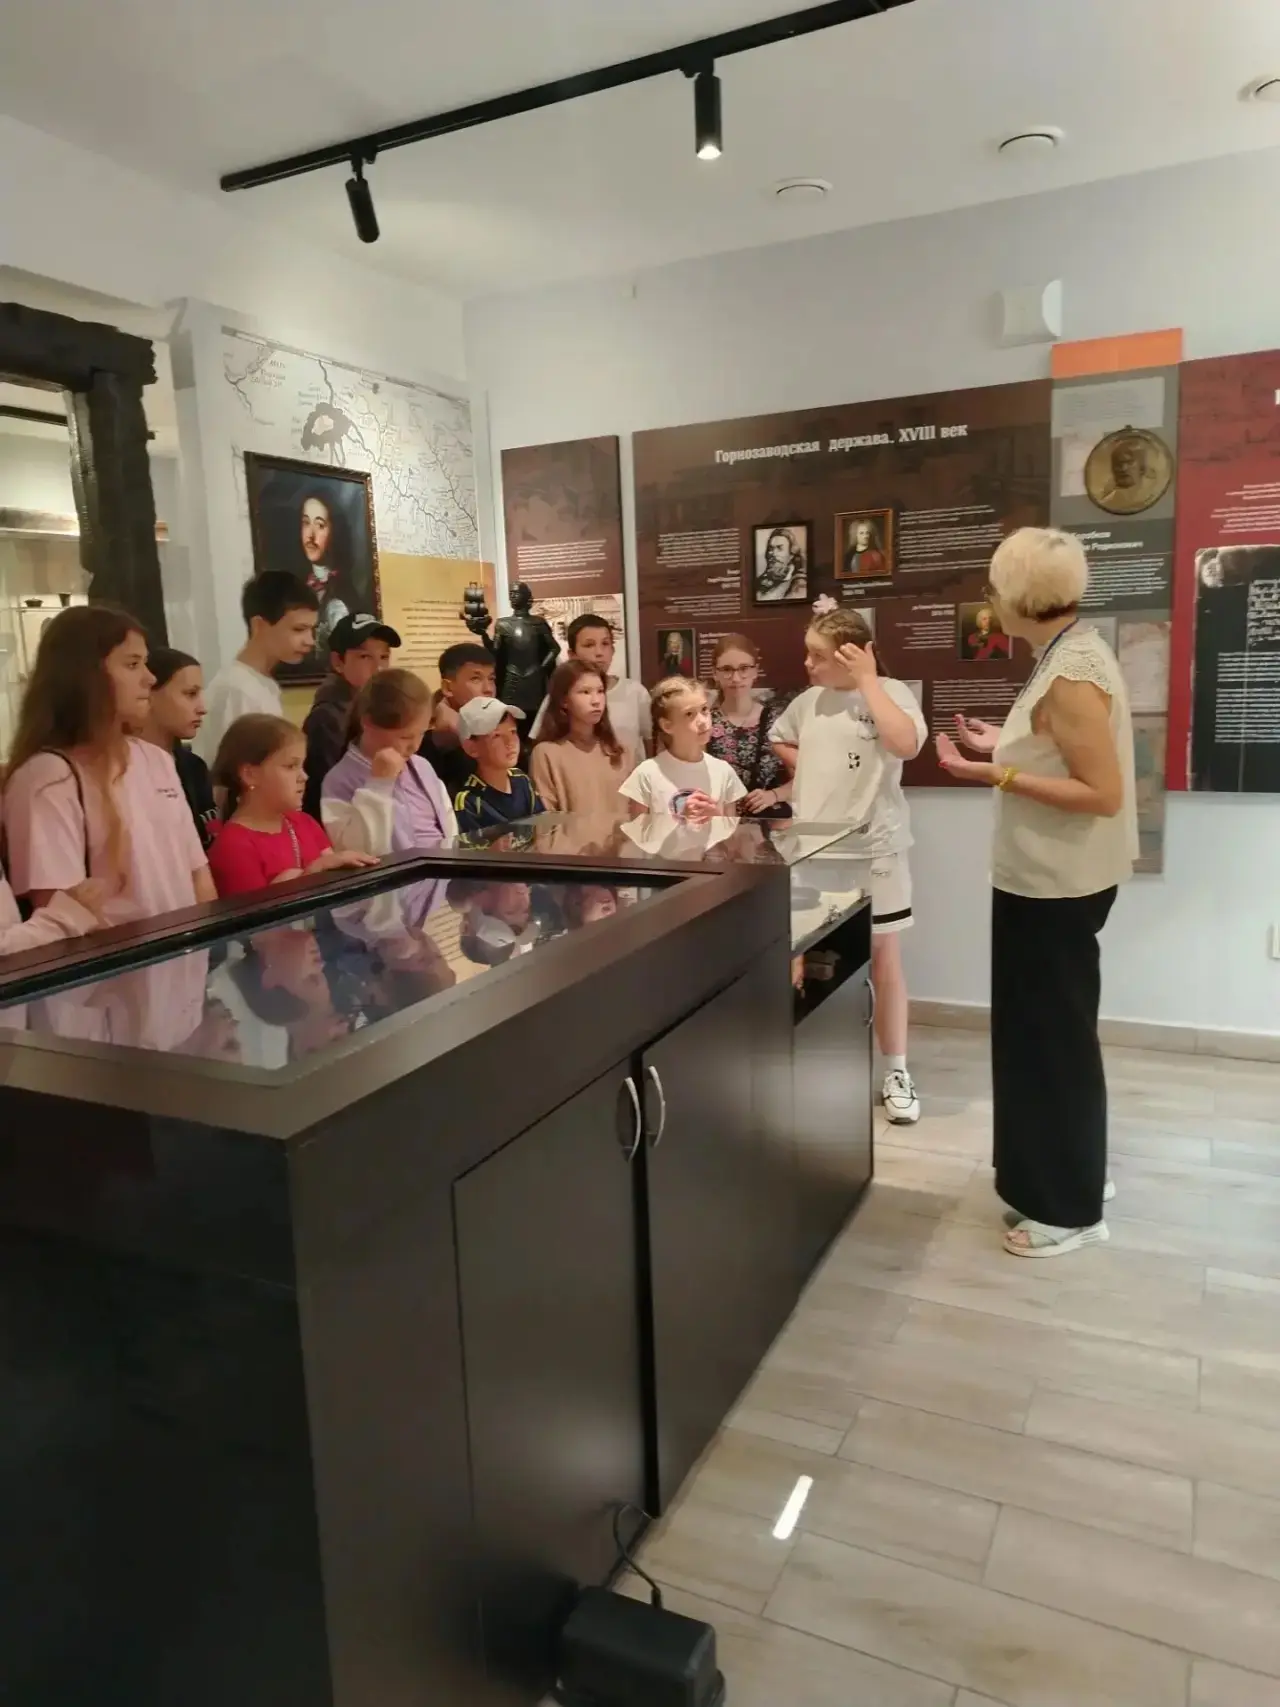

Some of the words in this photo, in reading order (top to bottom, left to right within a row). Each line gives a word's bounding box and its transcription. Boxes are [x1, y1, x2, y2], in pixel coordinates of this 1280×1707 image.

[715, 440, 821, 465] Горнозаводская
[828, 432, 895, 452] держава.
[898, 424, 936, 443] XVIII
[940, 423, 968, 439] век
